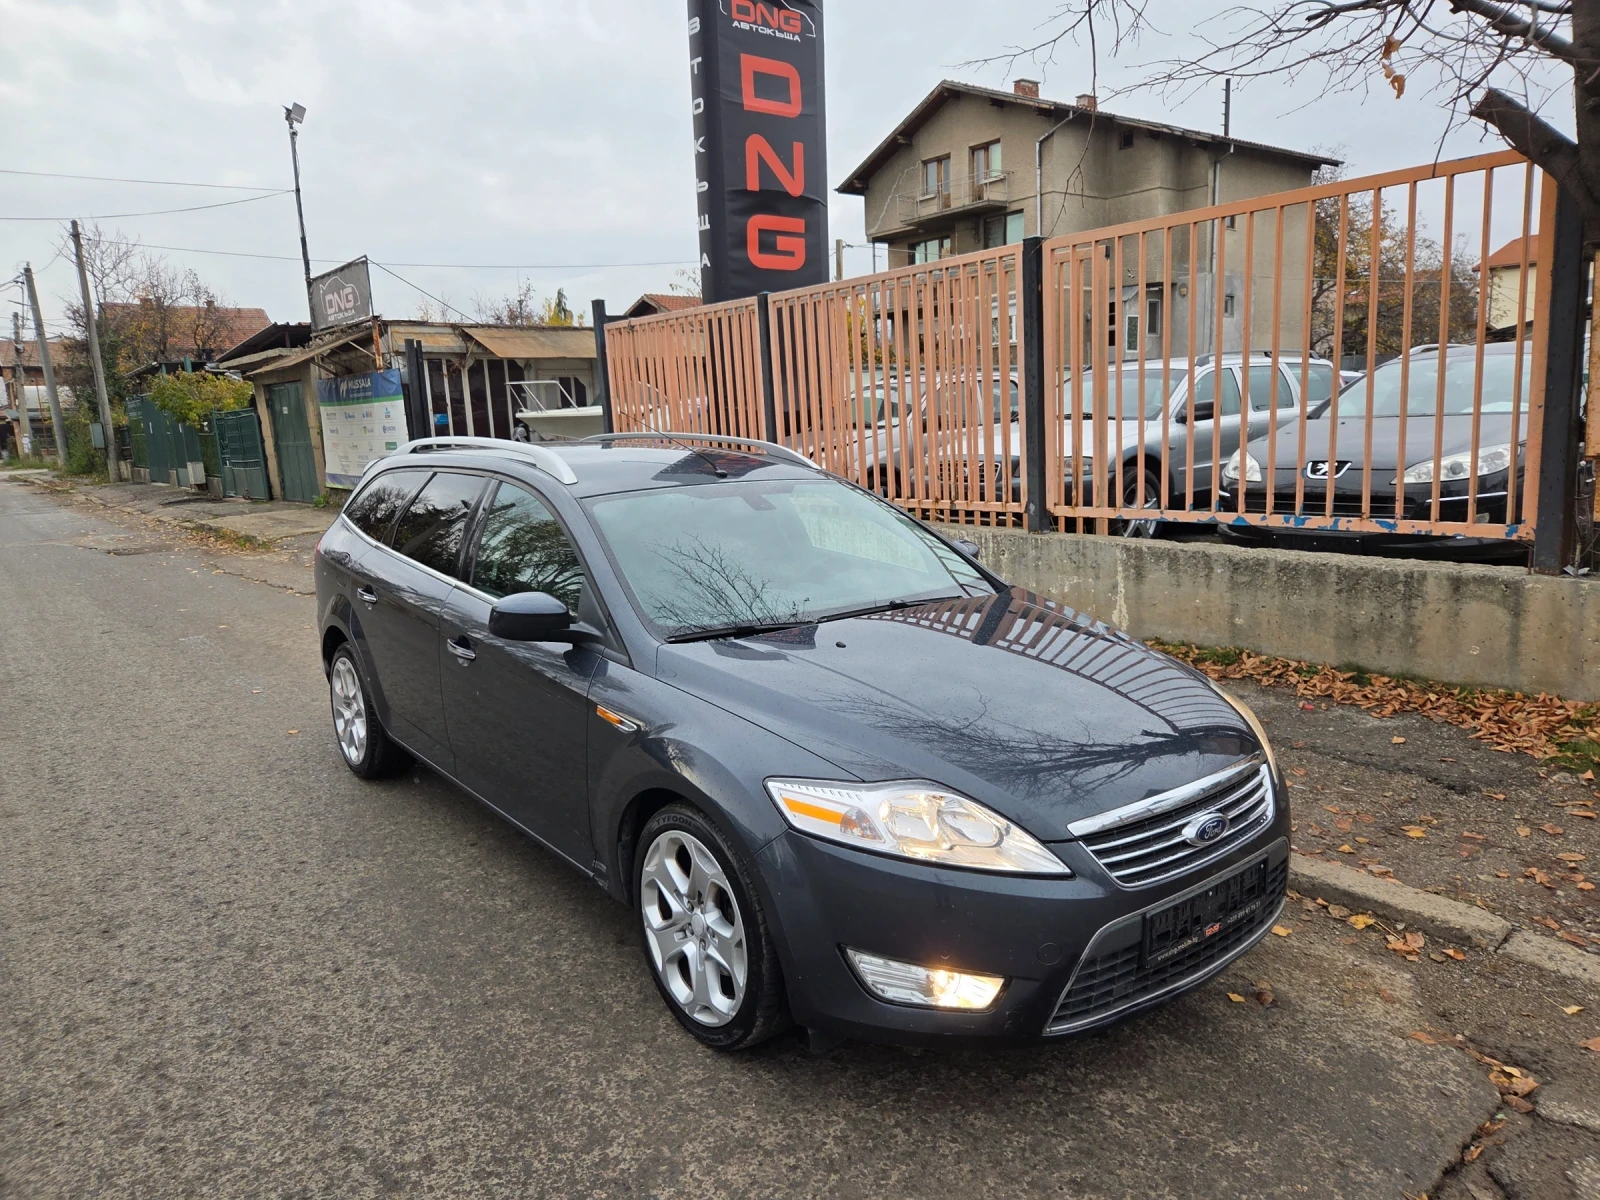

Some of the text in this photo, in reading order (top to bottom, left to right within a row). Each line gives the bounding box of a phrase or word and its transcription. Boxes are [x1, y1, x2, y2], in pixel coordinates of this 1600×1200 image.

[731, 0, 802, 34] DNG
[740, 53, 806, 271] DNG
[325, 287, 354, 315] DNG
[348, 378, 372, 390] MUSSALA
[656, 815, 692, 827] TYFOON
[1204, 821, 1222, 839] Ford
